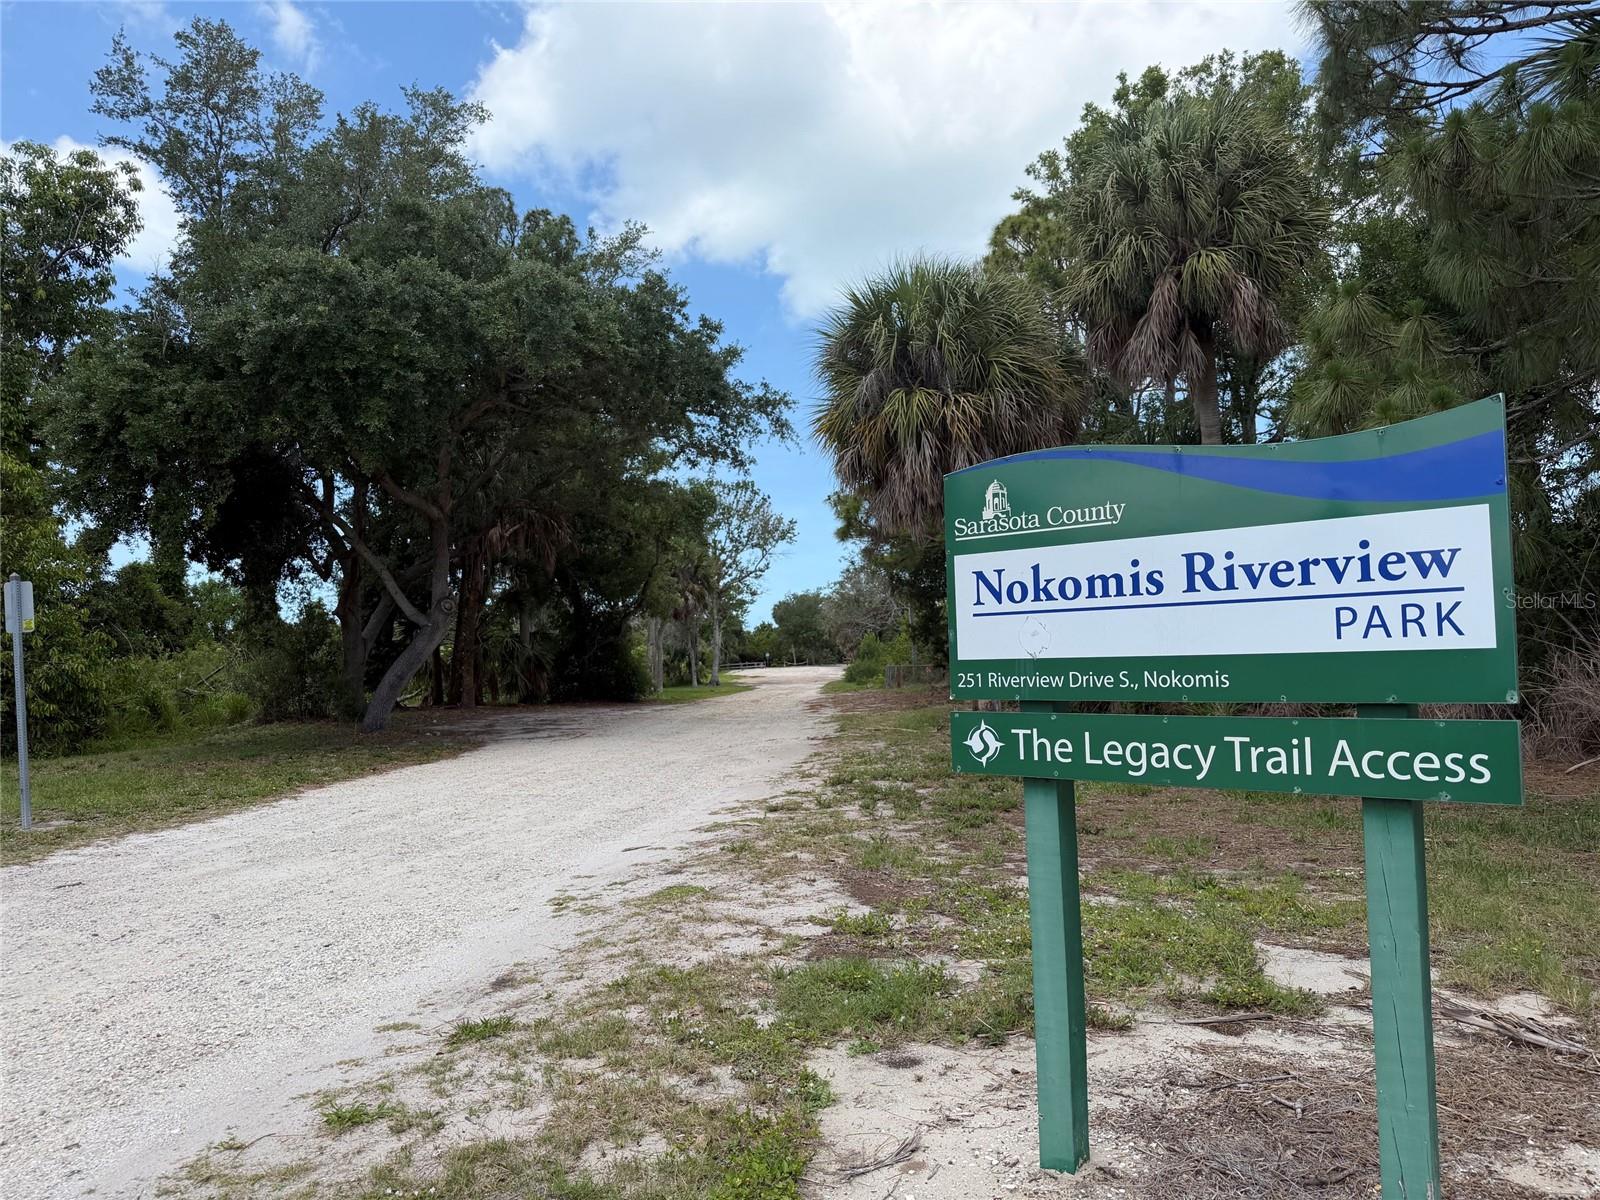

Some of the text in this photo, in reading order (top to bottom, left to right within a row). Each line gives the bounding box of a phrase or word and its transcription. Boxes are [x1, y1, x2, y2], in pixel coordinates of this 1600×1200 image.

[954, 500, 1126, 537] Sarasota County
[971, 539, 1462, 607] Nokomis Riverview
[1334, 601, 1466, 640] PARK
[957, 669, 1230, 691] 251 Riverview Drive S., Nokomis
[1010, 728, 1492, 784] The Legacy Trail Access
